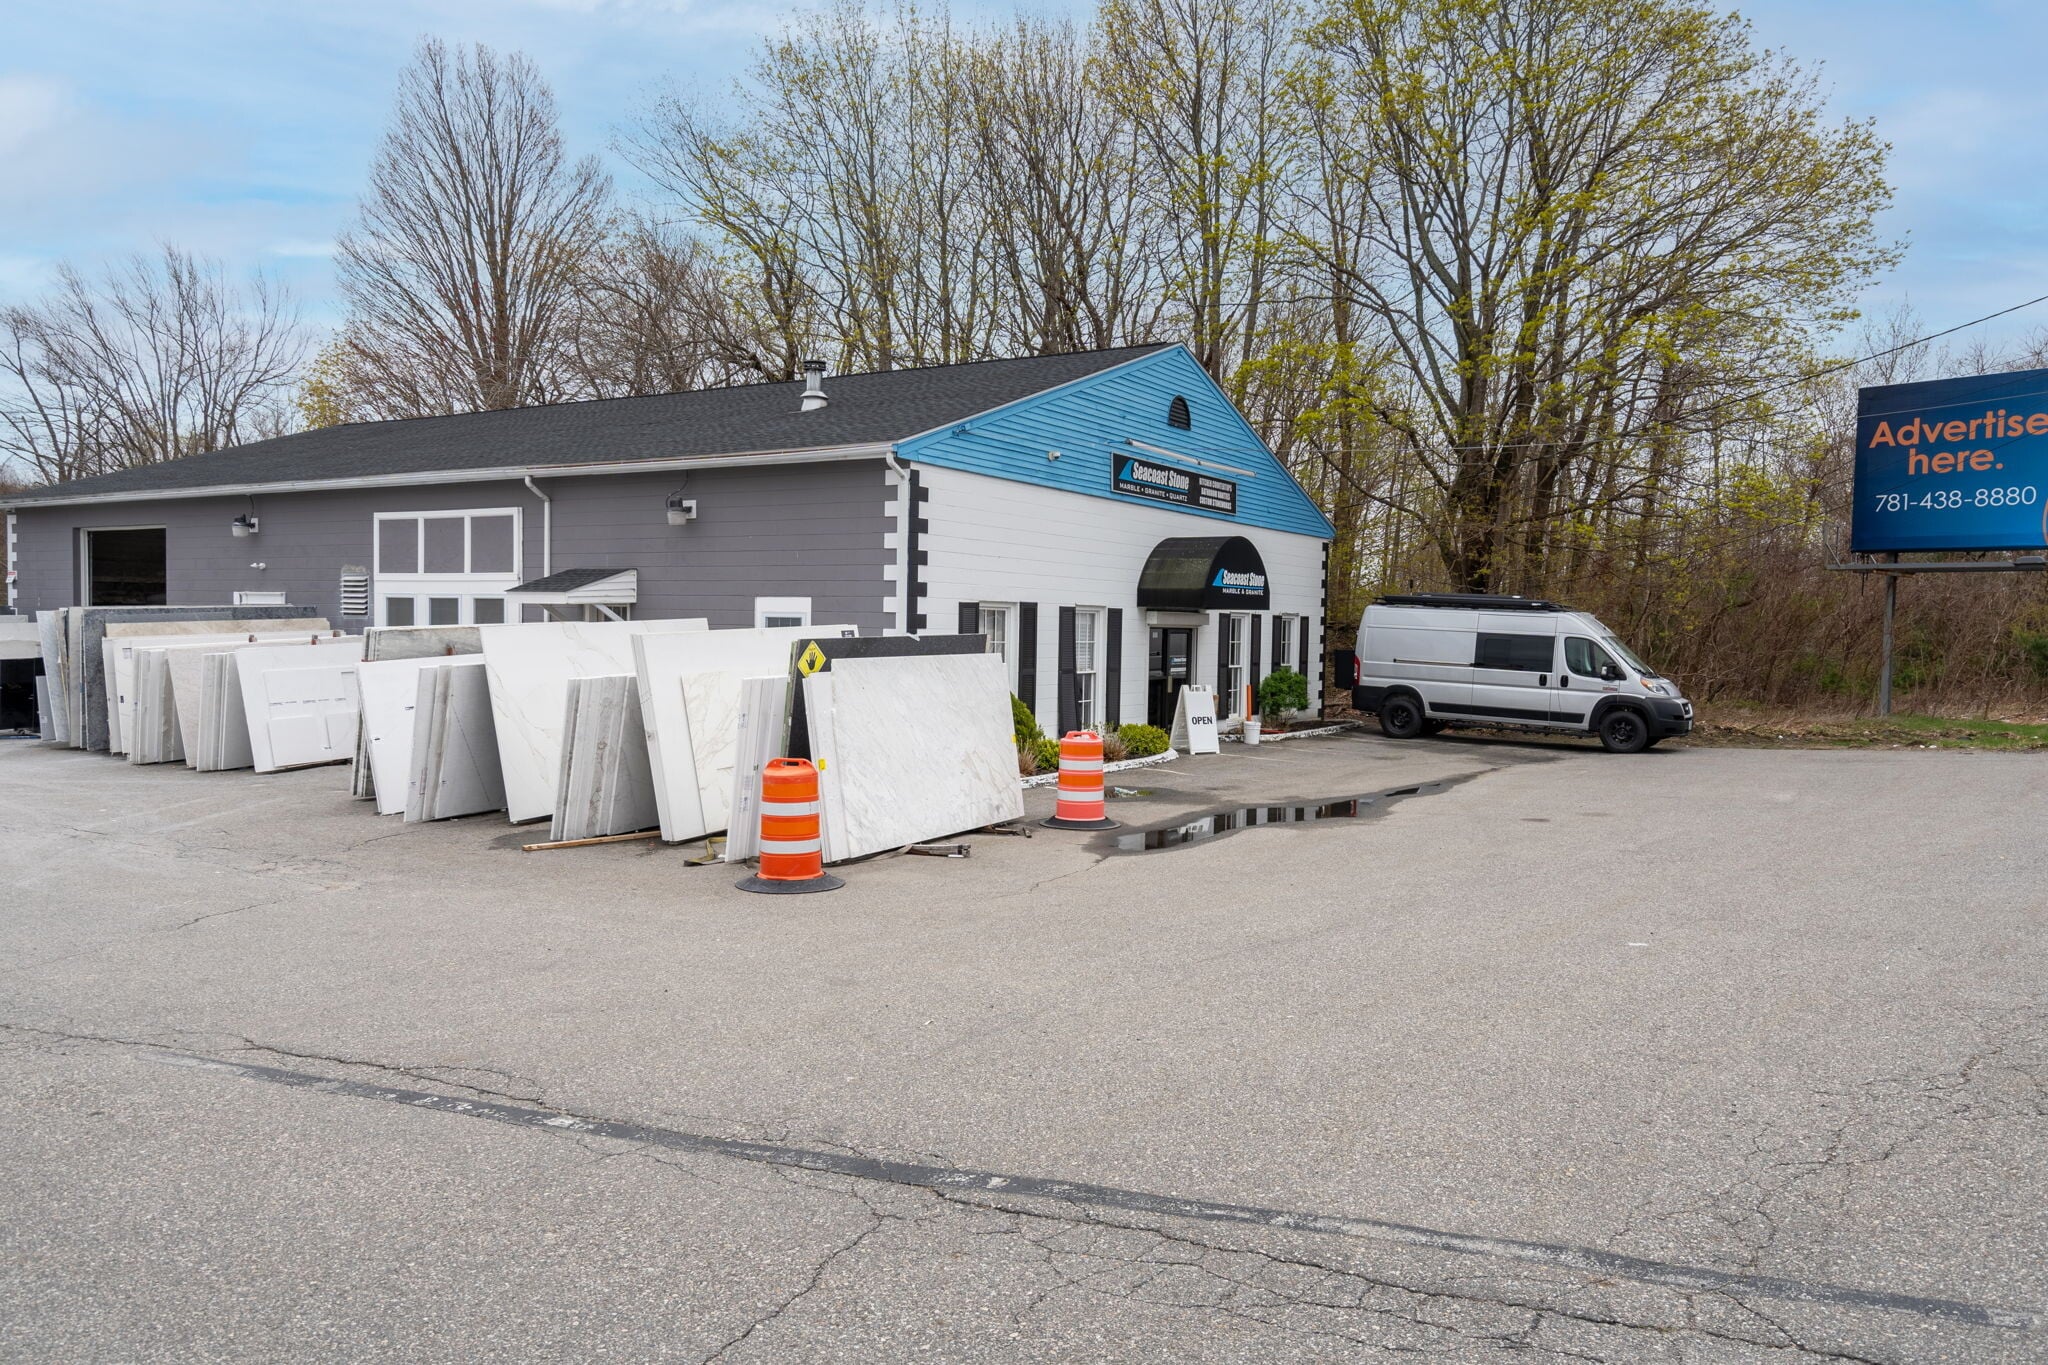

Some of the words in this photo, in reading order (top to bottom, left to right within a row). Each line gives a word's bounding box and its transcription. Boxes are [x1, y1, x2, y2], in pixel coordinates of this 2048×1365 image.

[1869, 409, 2048, 448] Advertise
[1908, 447, 2004, 476] here.
[1133, 462, 1168, 485] Seacoast
[1169, 470, 1189, 490] Stone
[1120, 482, 1140, 492] MARBLE
[1145, 487, 1165, 497] GRANITE
[1170, 493, 1188, 502] QUARTZ
[1875, 486, 2037, 512] 781-438-8880
[1223, 570, 1249, 585] Seacoast
[1249, 572, 1264, 586] Stone
[1192, 716, 1213, 725] OPEN
